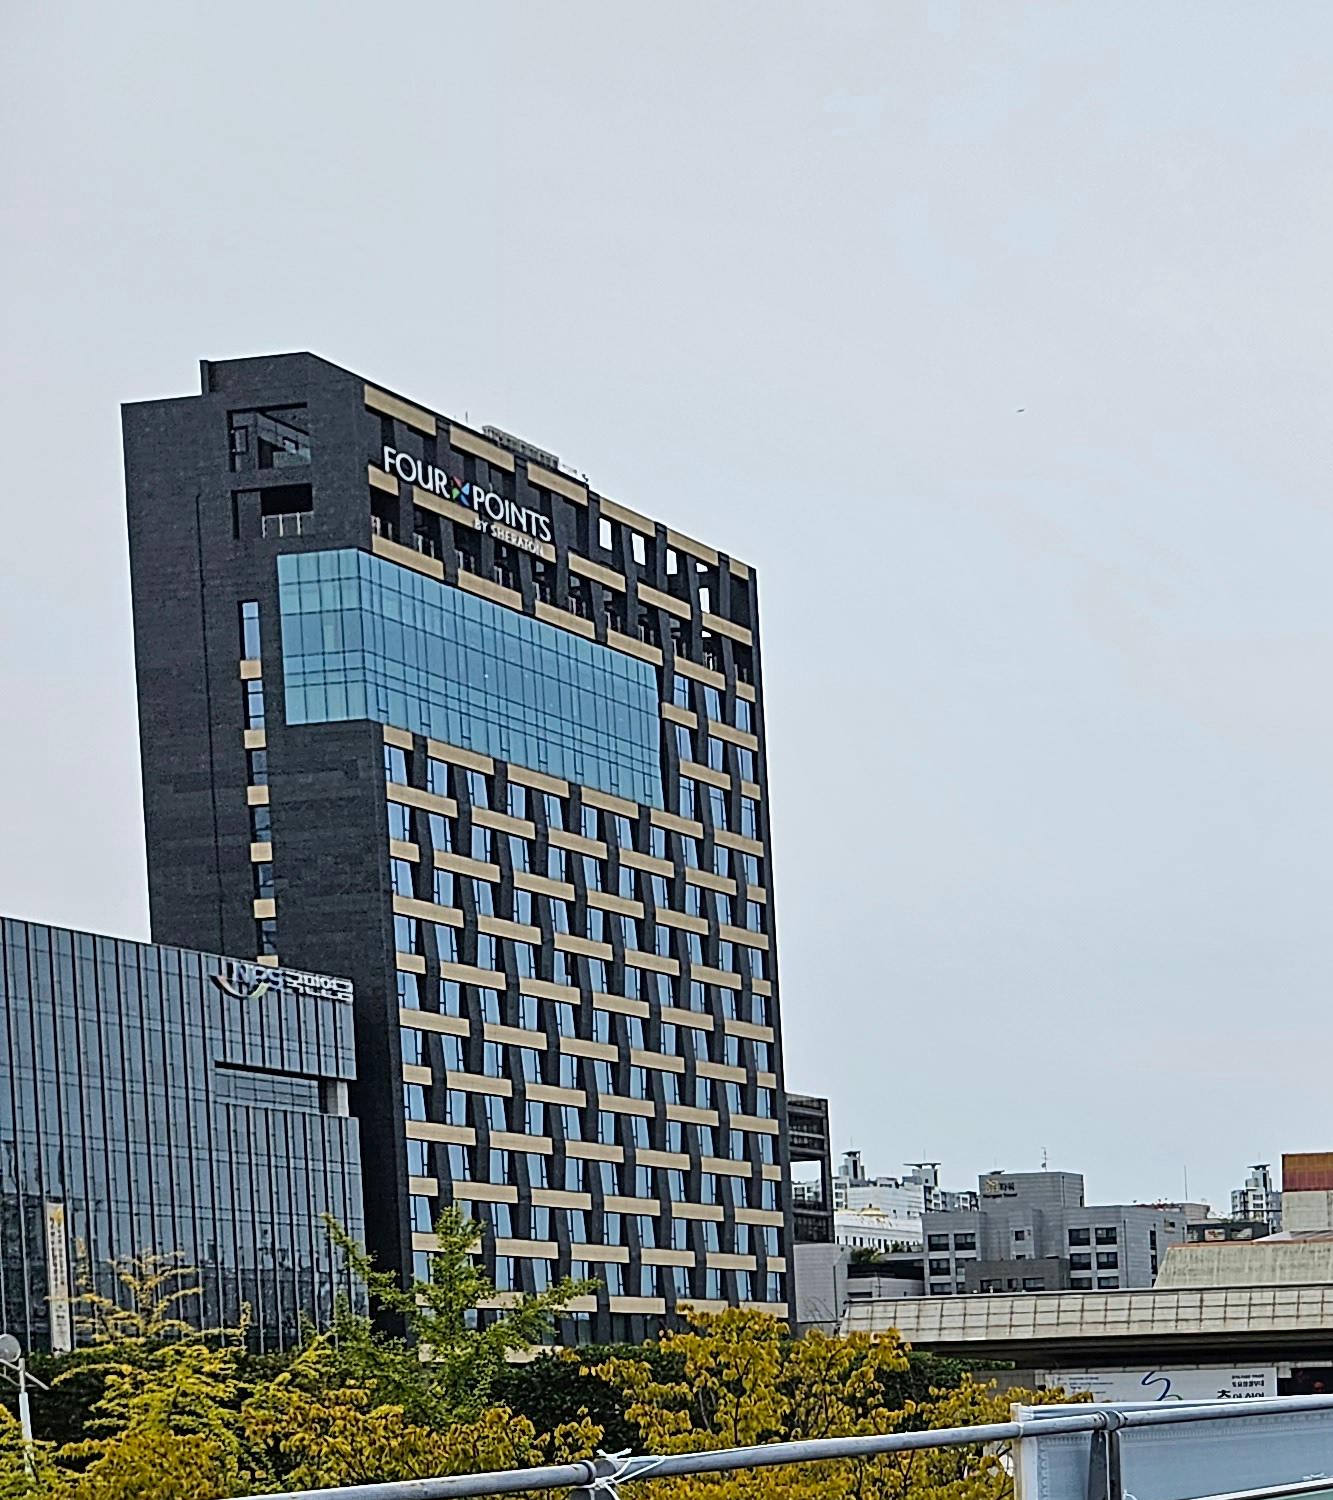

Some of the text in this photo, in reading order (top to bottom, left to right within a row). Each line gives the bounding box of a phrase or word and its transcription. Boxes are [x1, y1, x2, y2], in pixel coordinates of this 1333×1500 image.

[383, 445, 553, 542] FOUR POINTS
[474, 516, 545, 558] BY SHERATON
[231, 960, 284, 992] NPS
